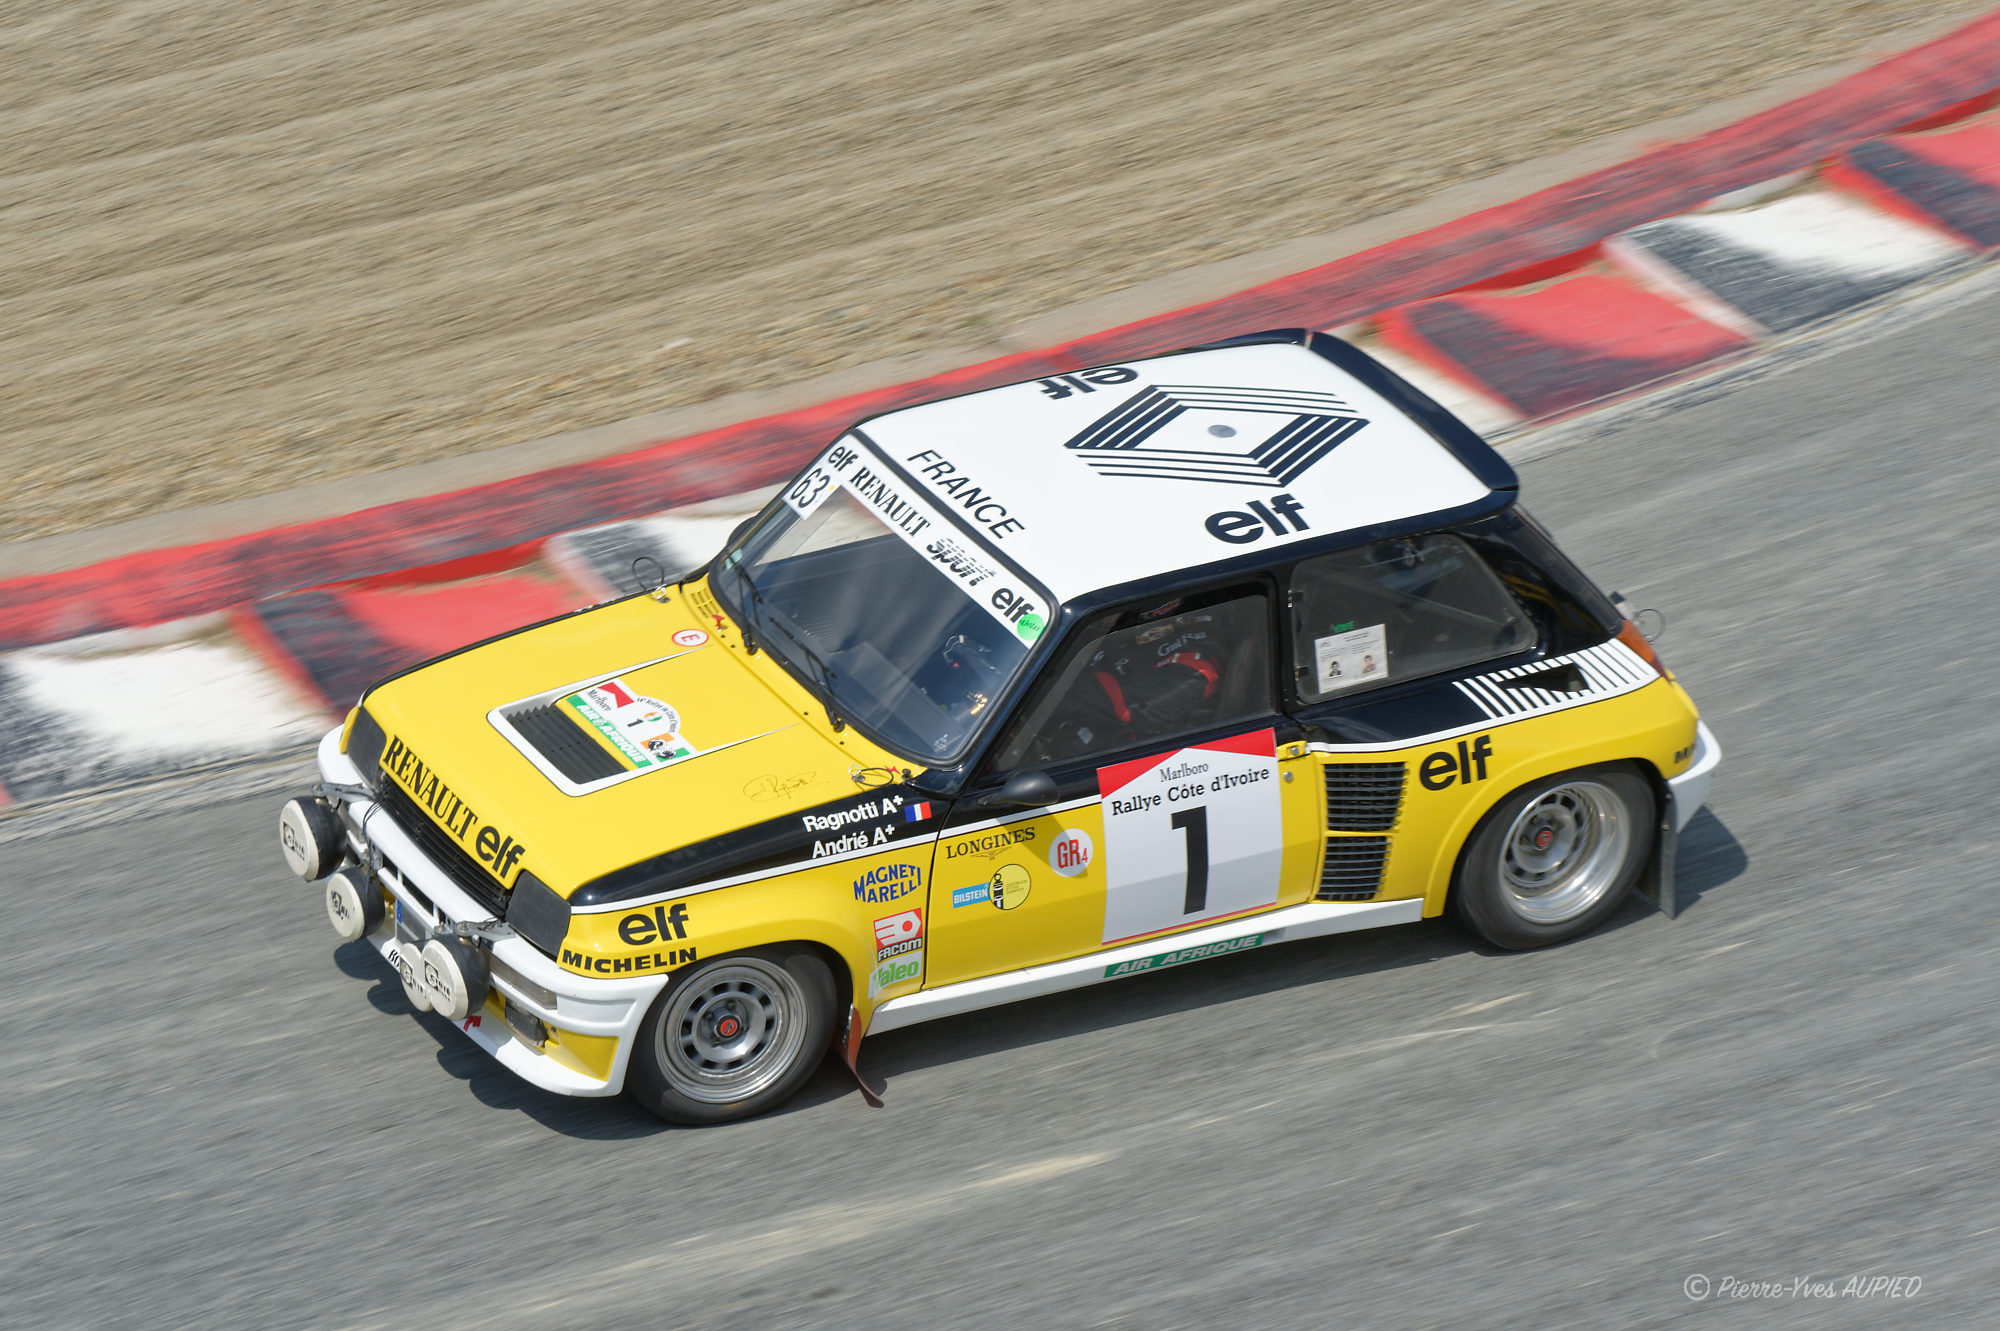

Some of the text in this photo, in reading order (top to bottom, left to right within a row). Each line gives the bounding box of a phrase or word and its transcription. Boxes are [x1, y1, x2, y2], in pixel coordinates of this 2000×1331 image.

[1037, 366, 1139, 400] elf
[790, 467, 831, 508] 63
[907, 449, 1026, 539] FRANCE
[828, 446, 859, 472] elf
[849, 466, 931, 537] RENAULT
[991, 588, 1035, 623] elf
[1205, 493, 1310, 544] elf
[576, 704, 601, 721] AIR
[599, 724, 646, 763] AFRIQUE
[1159, 761, 1209, 783] Marlboro
[1419, 734, 1493, 791] elf
[383, 734, 479, 841] RENAULT
[475, 826, 526, 879] elf
[1111, 767, 1270, 816] Rallye Côte d'Ivoire
[802, 794, 904, 832] Ragnotti A+
[812, 824, 895, 859] Andrié A+
[946, 827, 1036, 859] LONGINES
[1171, 805, 1209, 915] 1
[853, 864, 921, 902] MAGNETI
[853, 867, 921, 903] MARELLI
[954, 888, 988, 904] BILSTEIN
[618, 903, 689, 945] elf
[562, 947, 697, 973] MICHELIN
[878, 938, 922, 962] FACOM
[1112, 935, 1261, 976] AIR AFRIQUE
